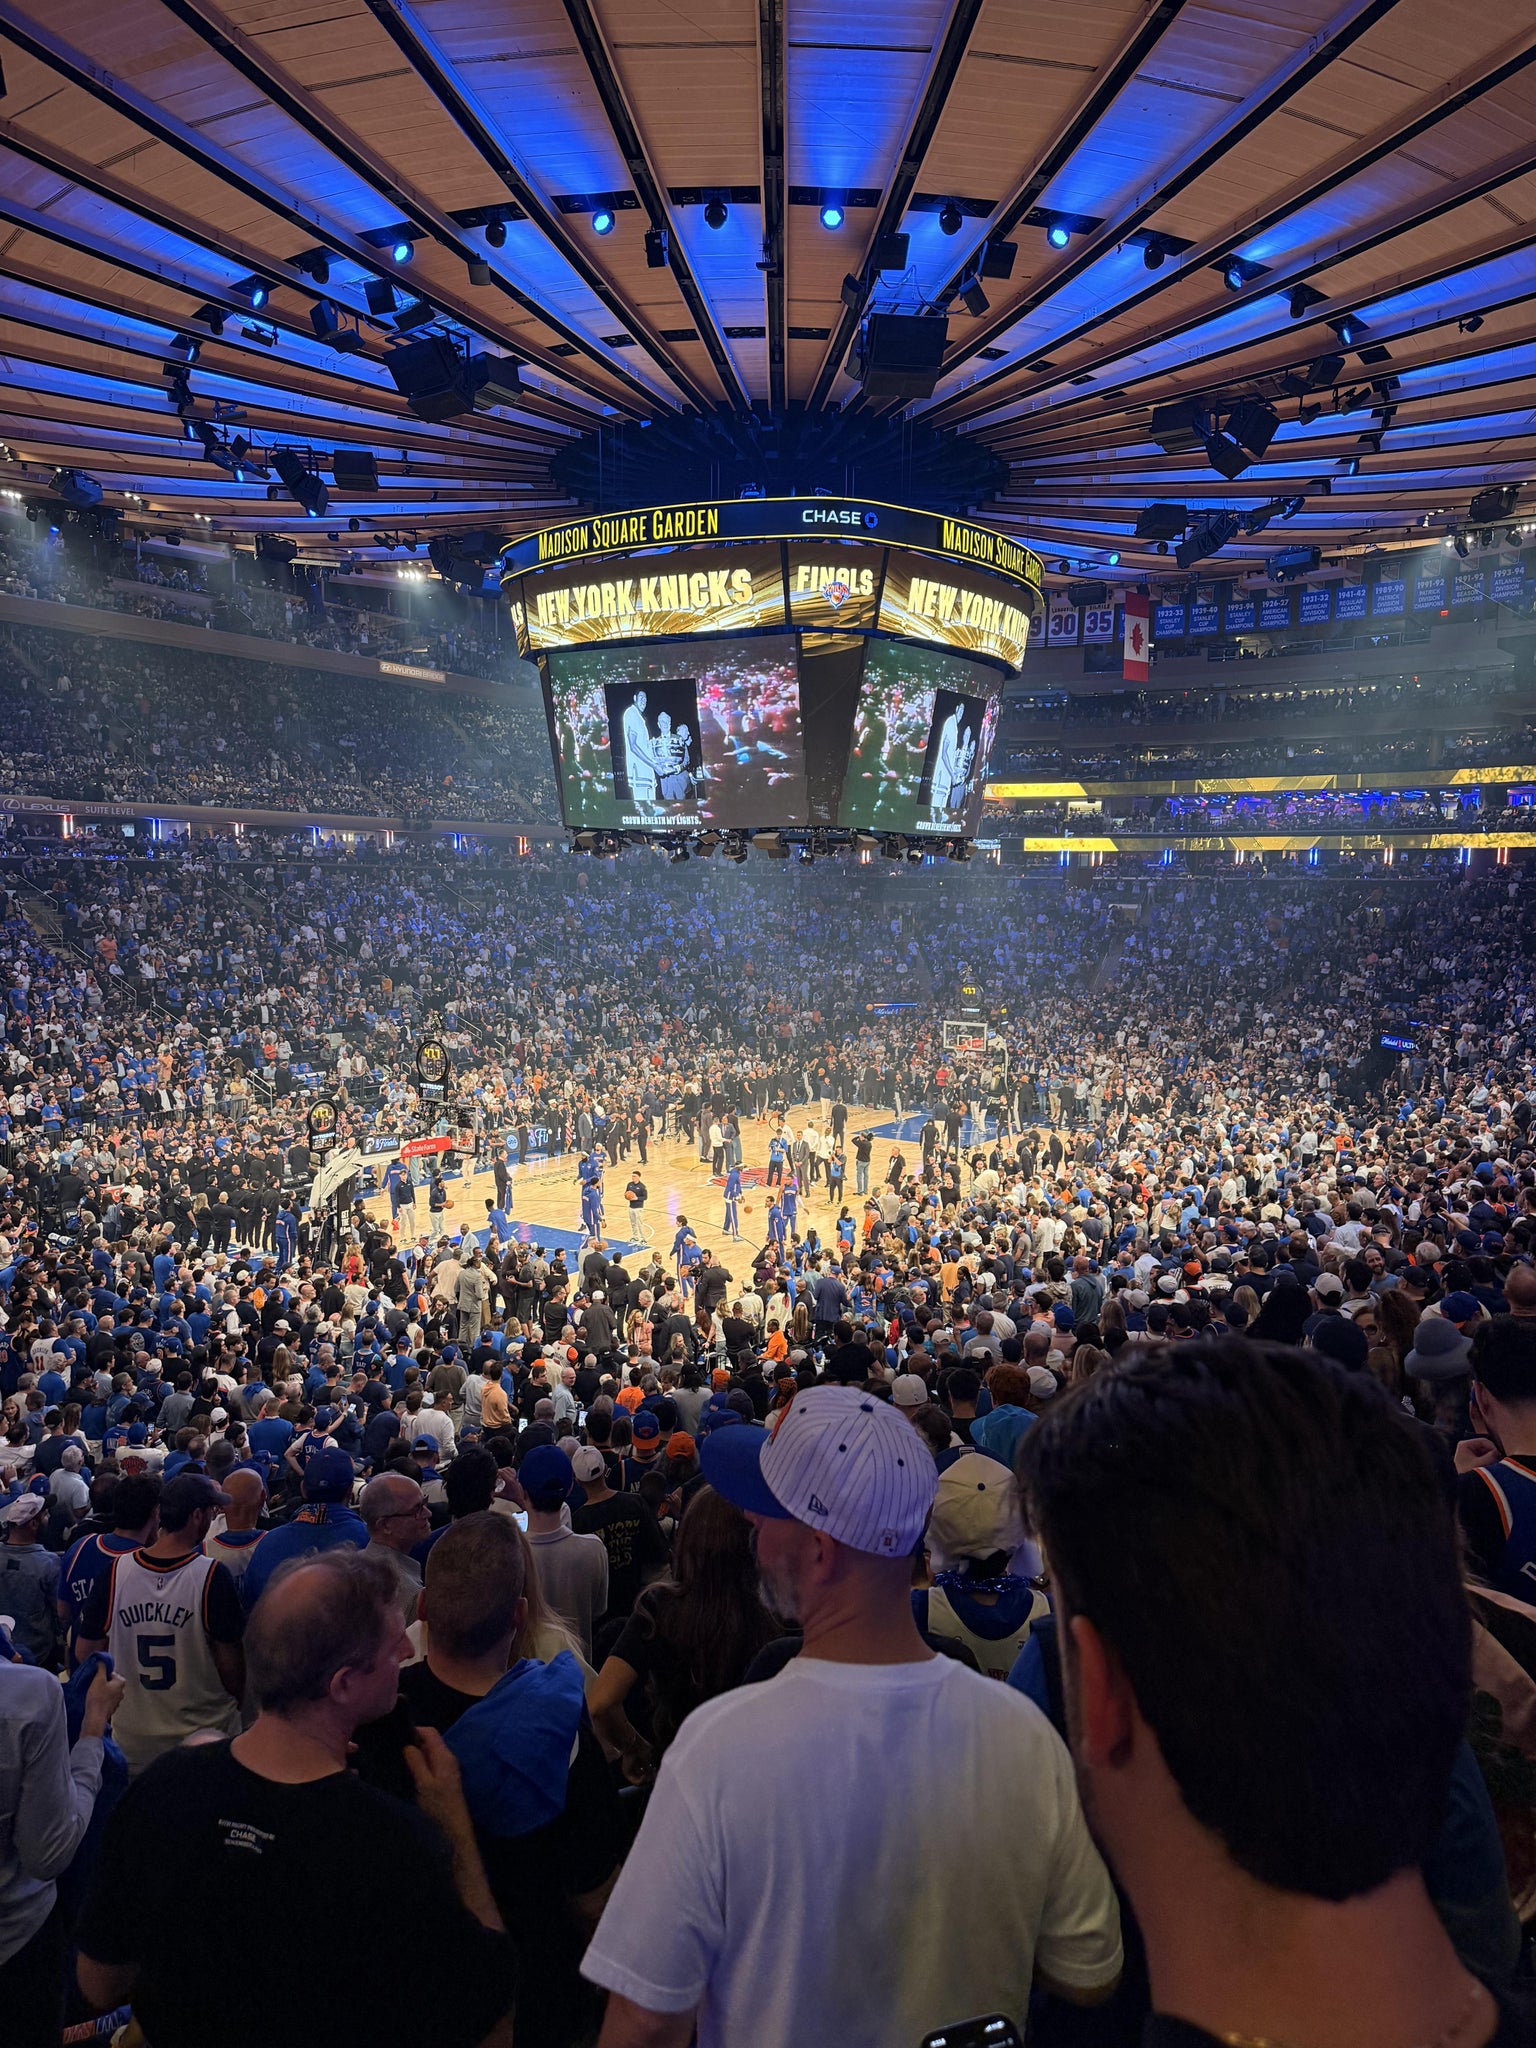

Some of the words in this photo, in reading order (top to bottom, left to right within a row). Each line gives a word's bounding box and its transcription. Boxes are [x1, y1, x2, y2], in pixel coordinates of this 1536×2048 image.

[802, 509, 862, 525] CHASE
[538, 525, 589, 561] MADISON
[592, 515, 647, 549] SQUARE
[652, 508, 718, 540] GARDEN
[942, 519, 994, 562] MADISON
[995, 536, 1025, 574] SQUARE
[796, 565, 874, 596] FINALS
[536, 588, 571, 628] NEW
[571, 579, 636, 619] YORK
[640, 568, 754, 613] KNICKS
[907, 577, 958, 620] NEW
[958, 590, 1004, 636] YORK
[1491, 590, 1524, 599] CHAMPIONS
[1029, 615, 1042, 637] 9
[1051, 614, 1076, 636] 30
[1086, 610, 1112, 633] 35
[21, 802, 70, 812] LEXUS
[85, 806, 109, 814] SUITE
[111, 807, 135, 816] LEVEL
[119, 1602, 194, 1629] QUICKLEY
[137, 1634, 177, 1690] 5
